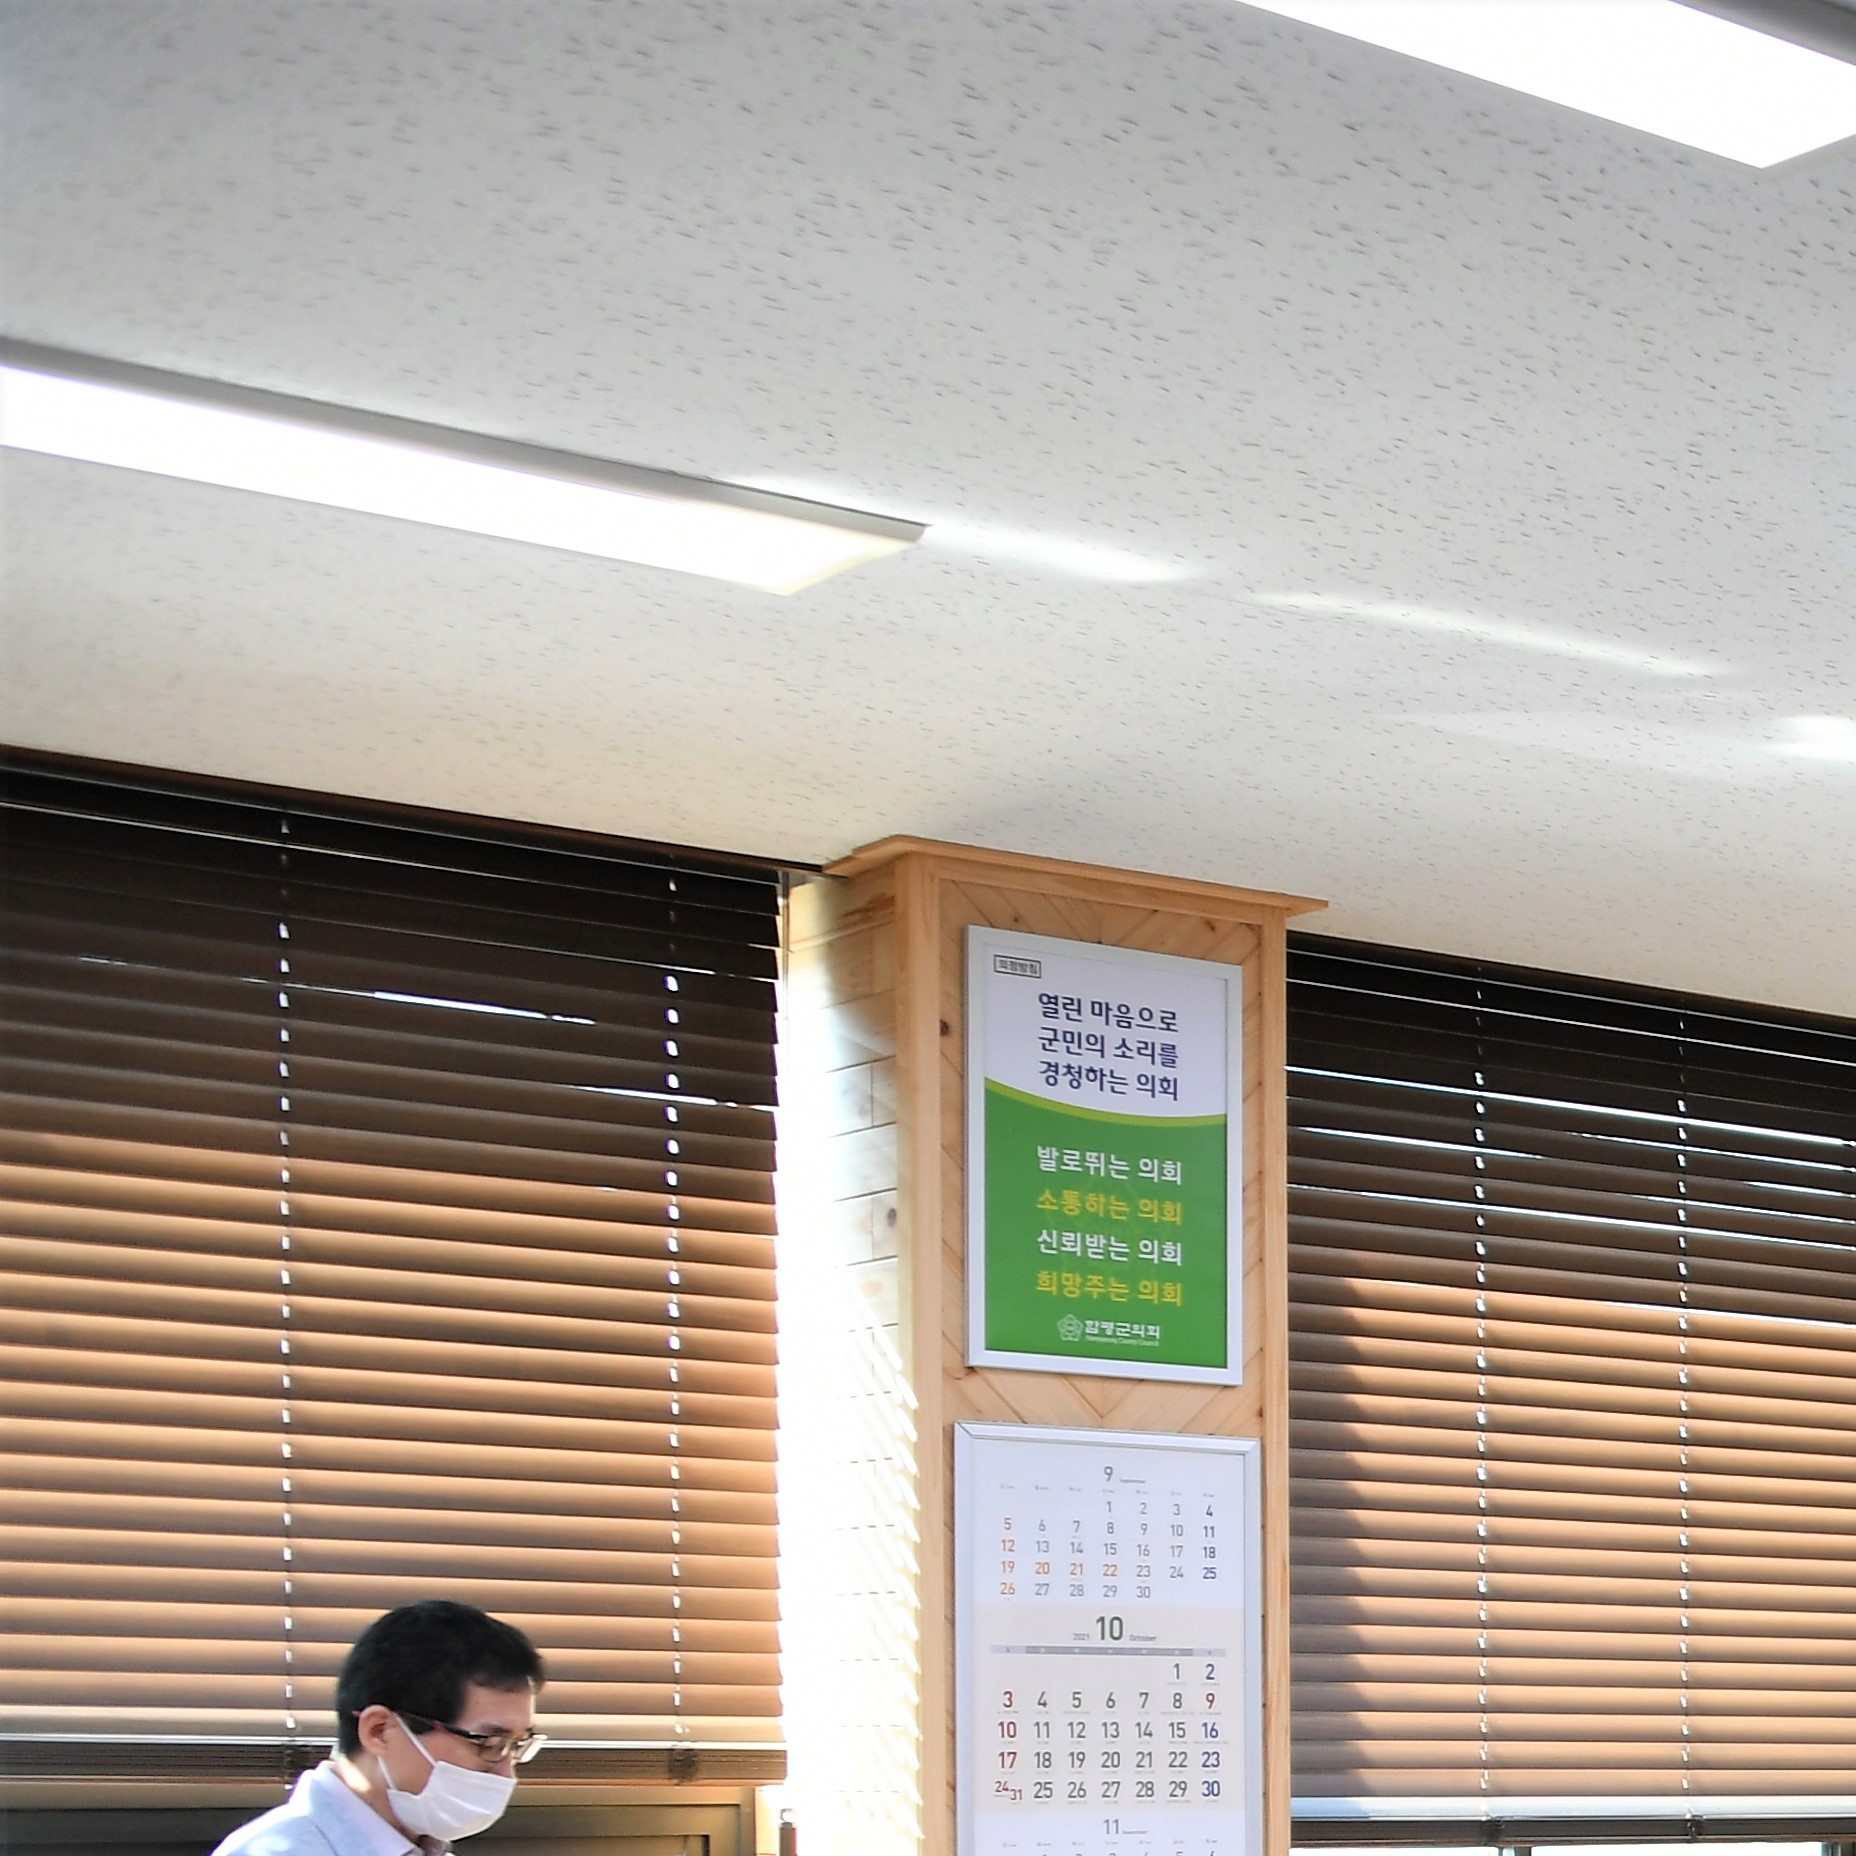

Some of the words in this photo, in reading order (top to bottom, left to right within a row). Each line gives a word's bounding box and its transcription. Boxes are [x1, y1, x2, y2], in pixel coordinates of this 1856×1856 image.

[1038, 993, 1082, 1022] 열린
[1091, 997, 1179, 1034] 마음으로
[1038, 1027, 1105, 1059] 군민의
[1113, 1038, 1179, 1068] 소리를
[1038, 1061, 1128, 1095] 경청하는
[1137, 1074, 1179, 1101] 의회
[1037, 1146, 1130, 1181] 발로뛰는
[1138, 1158, 1182, 1185] 의회
[1036, 1189, 1130, 1220] 소통하는
[1138, 1199, 1182, 1225] 의회
[1037, 1229, 1130, 1263] 신뢰받는
[1138, 1240, 1182, 1266] 의회
[1036, 1270, 1130, 1302] 희망주는
[1138, 1281, 1182, 1306] 의회
[1084, 1320, 1160, 1340] 함평군의회
[1103, 1466, 1114, 1482] 9
[1106, 1501, 1112, 1513] 1
[1140, 1502, 1147, 1515] 2
[1173, 1503, 1180, 1516] 3
[1205, 1504, 1214, 1516] 4
[1003, 1518, 1011, 1530] 5
[1038, 1519, 1046, 1532] 6
[1072, 1520, 1081, 1532] 7
[1107, 1521, 1115, 1534] 8
[1140, 1522, 1148, 1535] 9
[1170, 1524, 1184, 1536] 10
[1203, 1525, 1215, 1537] 11
[1001, 1539, 1015, 1552] 12
[1036, 1540, 1049, 1552] 13
[1070, 1541, 1084, 1553] 14
[1103, 1542, 1117, 1555] 15
[1137, 1544, 1150, 1556] 16
[1170, 1544, 1184, 1557] 17
[1202, 1546, 1216, 1558] 18
[1002, 1560, 1015, 1572] 19
[1035, 1561, 1050, 1574] 20
[1070, 1562, 1083, 1575] 21
[1103, 1564, 1118, 1577] 22
[1136, 1564, 1151, 1577] 23
[1169, 1565, 1184, 1578] 24
[1202, 1566, 1217, 1579] 25
[1000, 1582, 1016, 1594] 26
[1035, 1582, 1050, 1595] 27
[1069, 1584, 1084, 1597] 28
[1103, 1585, 1117, 1598] 29
[1136, 1585, 1151, 1598] 30
[1096, 1616, 1124, 1641] 10
[1173, 1662, 1180, 1679] 1
[1205, 1663, 1216, 1680] 2
[1002, 1690, 1014, 1708] 3
[1037, 1691, 1048, 1707] 4
[1072, 1691, 1082, 1708] 5
[1105, 1691, 1116, 1708] 6
[1138, 1691, 1150, 1708] 7
[1172, 1692, 1183, 1709] 8
[1205, 1692, 1216, 1709] 9
[997, 1720, 1017, 1738] 10
[1033, 1721, 1050, 1738] 11
[1067, 1721, 1087, 1738] 12
[1101, 1721, 1120, 1738] 13
[1134, 1721, 1154, 1738] 14
[1168, 1721, 1186, 1738] 15
[1201, 1721, 1219, 1738] 16
[998, 1751, 1018, 1768] 17
[1033, 1751, 1052, 1768] 18
[1068, 1751, 1086, 1768] 19
[1100, 1751, 1121, 1768] 20
[1135, 1750, 1153, 1768] 21
[1168, 1750, 1188, 1768] 22
[1201, 1750, 1221, 1768] 23
[994, 1780, 1009, 1793] 24
[1009, 1789, 1023, 1801] 31
[1033, 1781, 1054, 1798] 25
[1067, 1781, 1087, 1798] 26
[1101, 1780, 1121, 1798] 27
[1135, 1780, 1155, 1797] 28
[1168, 1780, 1188, 1797] 29
[1201, 1779, 1221, 1797] 30
[1103, 1819, 1119, 1835] 11
